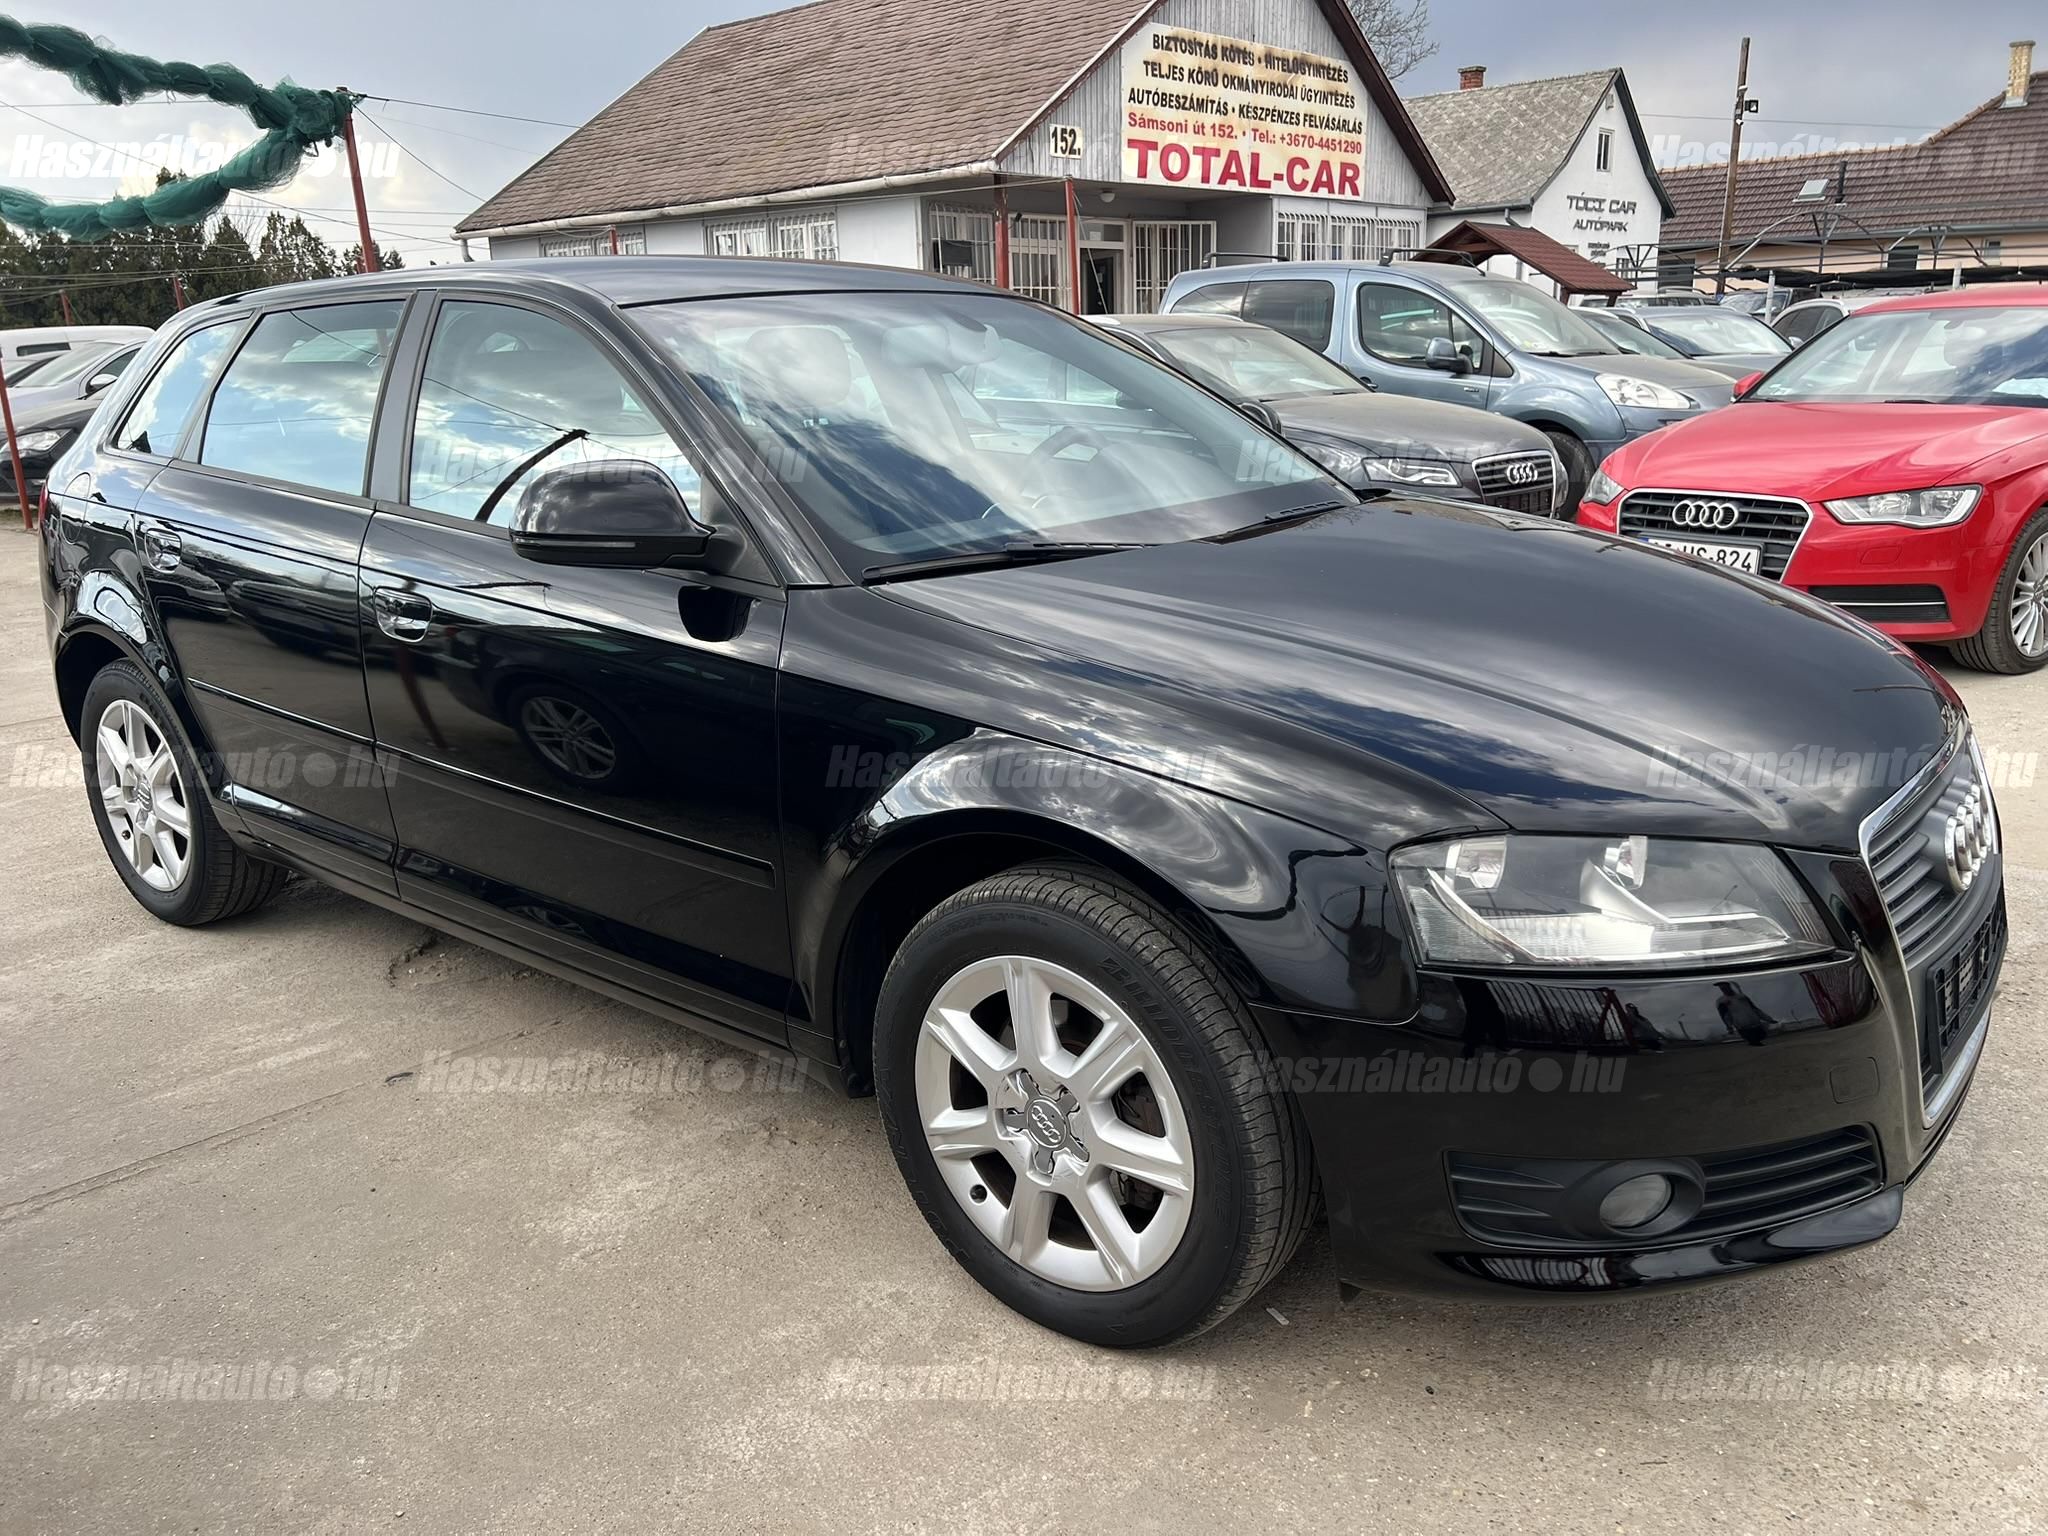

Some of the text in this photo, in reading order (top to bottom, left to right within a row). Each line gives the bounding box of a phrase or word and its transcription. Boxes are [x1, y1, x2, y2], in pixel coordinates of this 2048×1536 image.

[1153, 34, 1218, 60] BIZTOSÍTÁS
[1222, 44, 1254, 66] KÖTÉS
[1143, 60, 1184, 82] TELJES
[1222, 73, 1298, 100] OKMÁNYIRODAI
[1300, 85, 1355, 109] ÜGYINTÉZÉS
[1128, 87, 1363, 135] AUTÓBESZÁMÍTÁS KÉSZPÉNZES FELVÁSÁRLÁS
[1051, 127, 1081, 156] 152.
[1128, 112, 1362, 154] Sámsoni út 152. Tel.: +3670-4451290
[1127, 138, 1360, 197] TOTAL-CAR
[1573, 216, 1628, 232] AUTÓPARK
[1609, 200, 1637, 214] CAR
